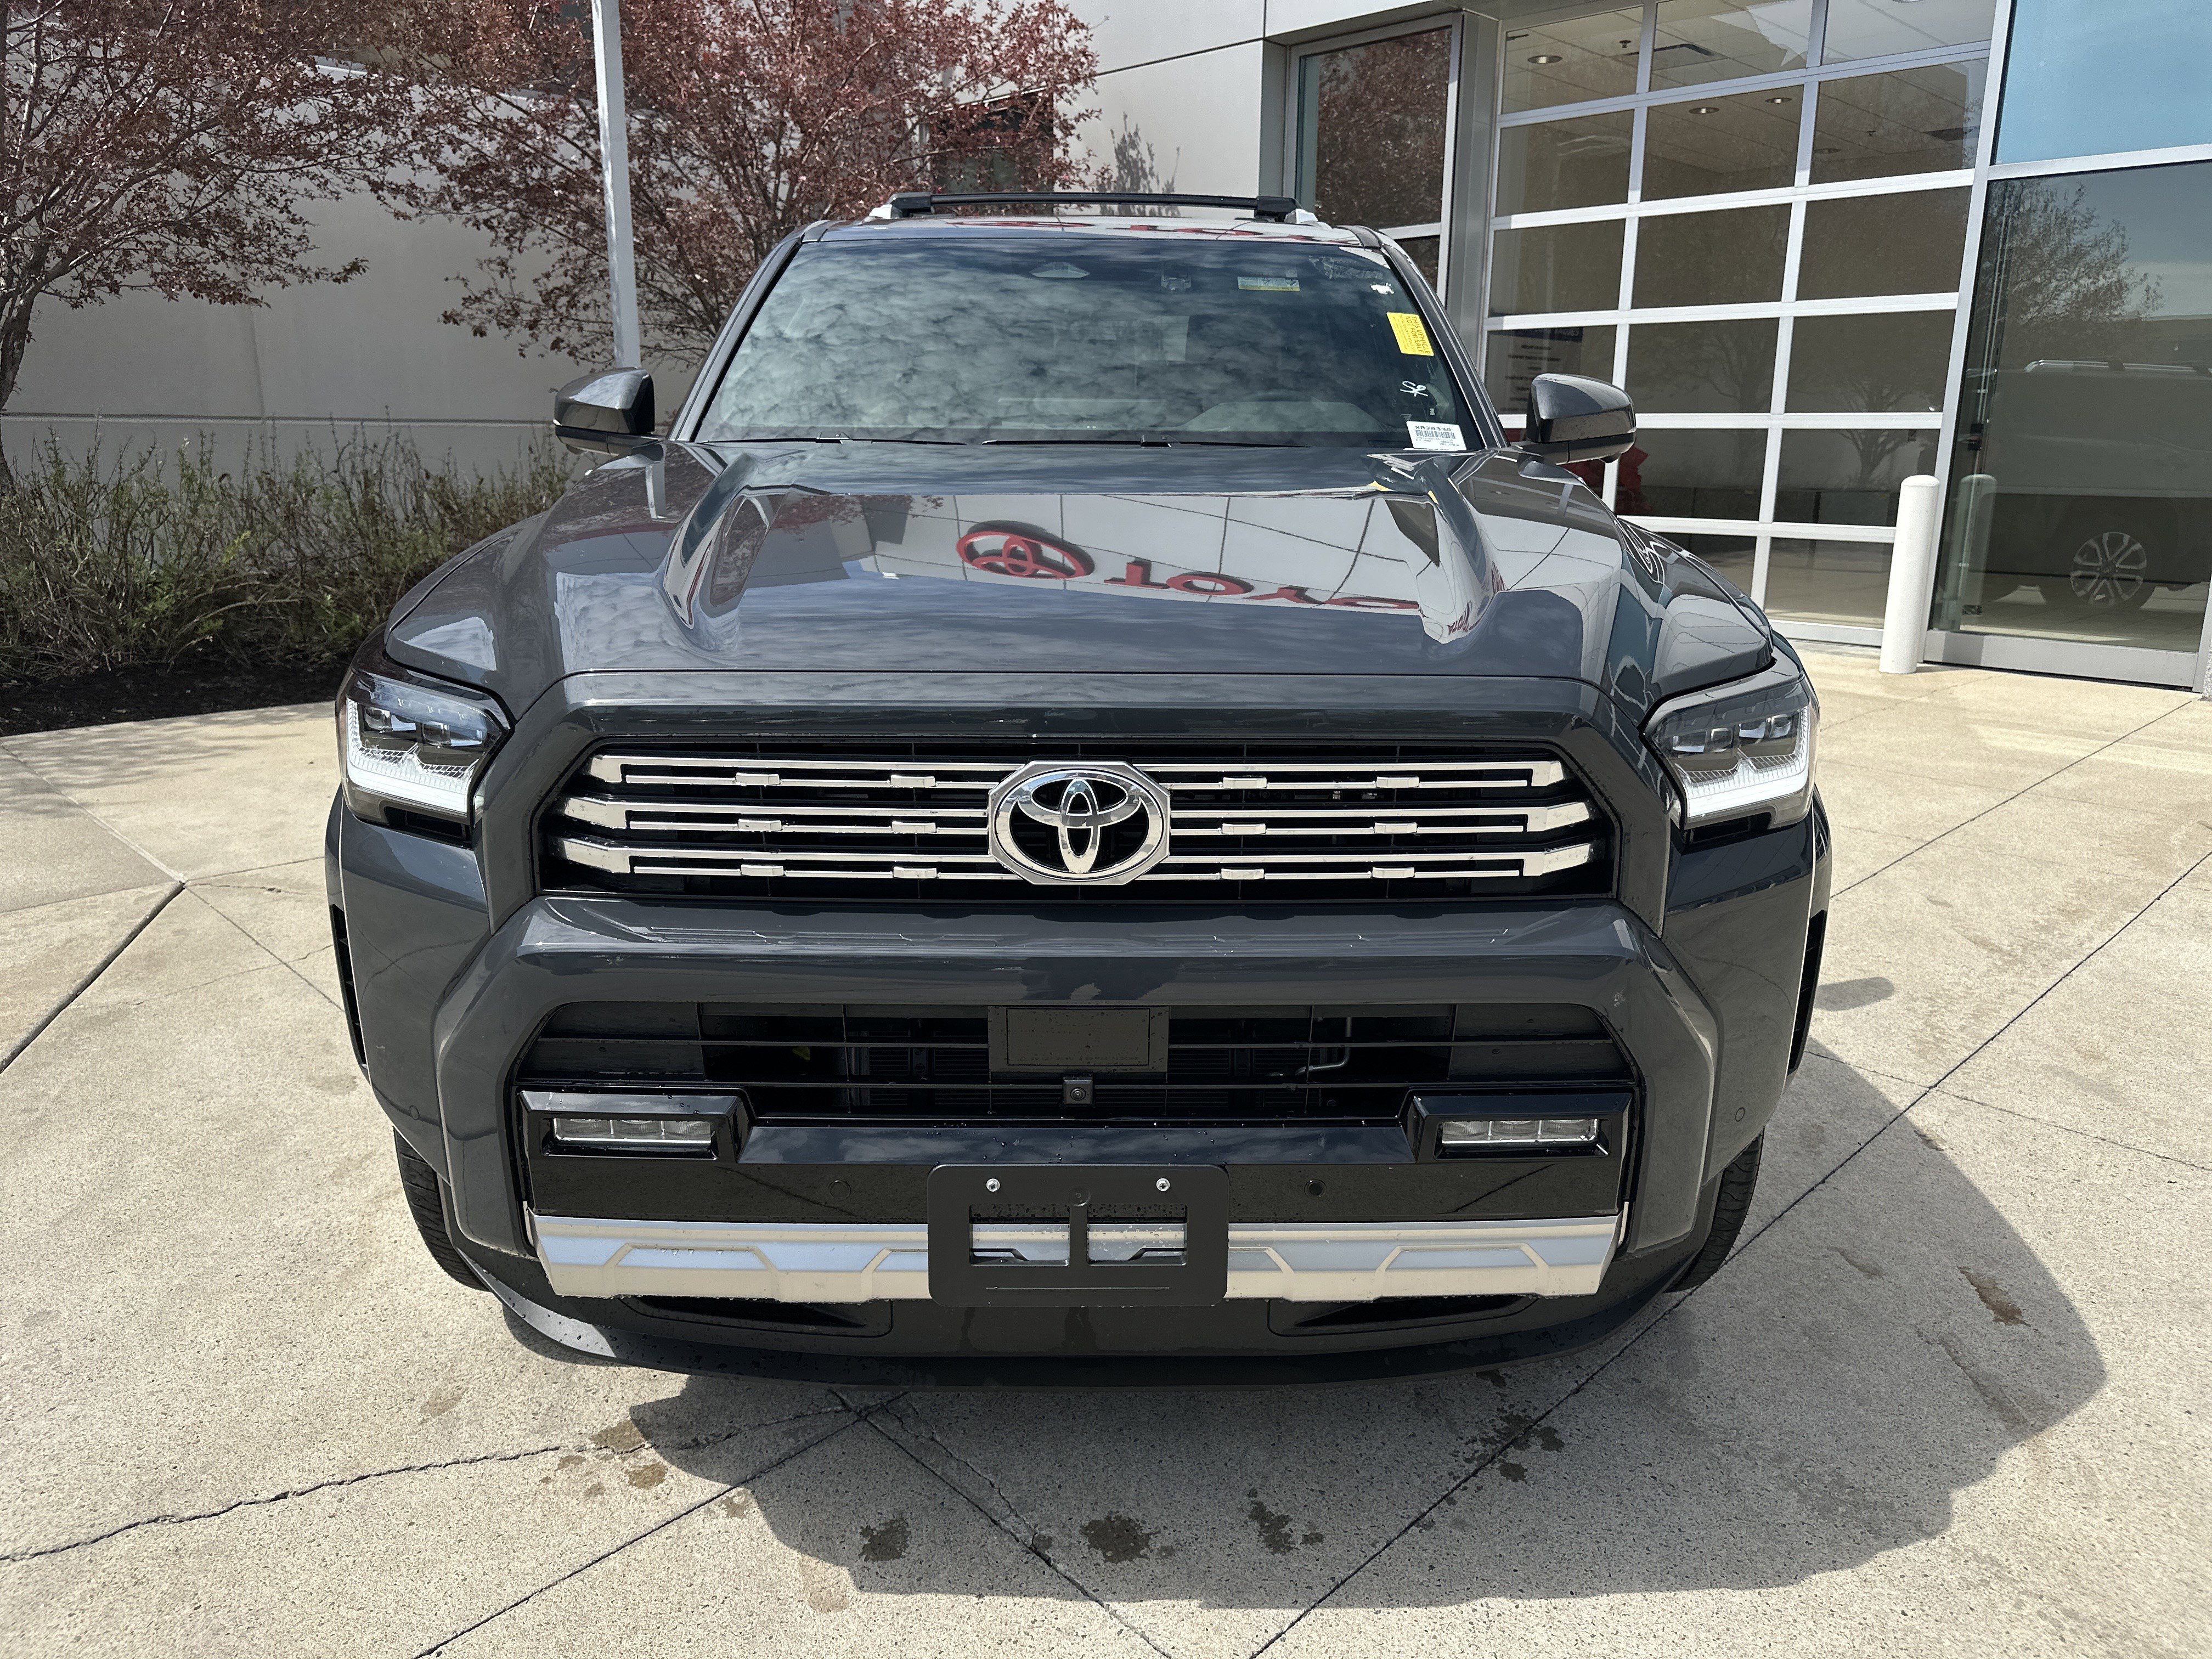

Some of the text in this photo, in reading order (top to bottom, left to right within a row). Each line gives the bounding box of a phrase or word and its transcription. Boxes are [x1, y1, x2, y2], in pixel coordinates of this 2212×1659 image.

[1412, 316, 1431, 354] THIS VEHICLE
[1415, 340, 1424, 353] SALE
